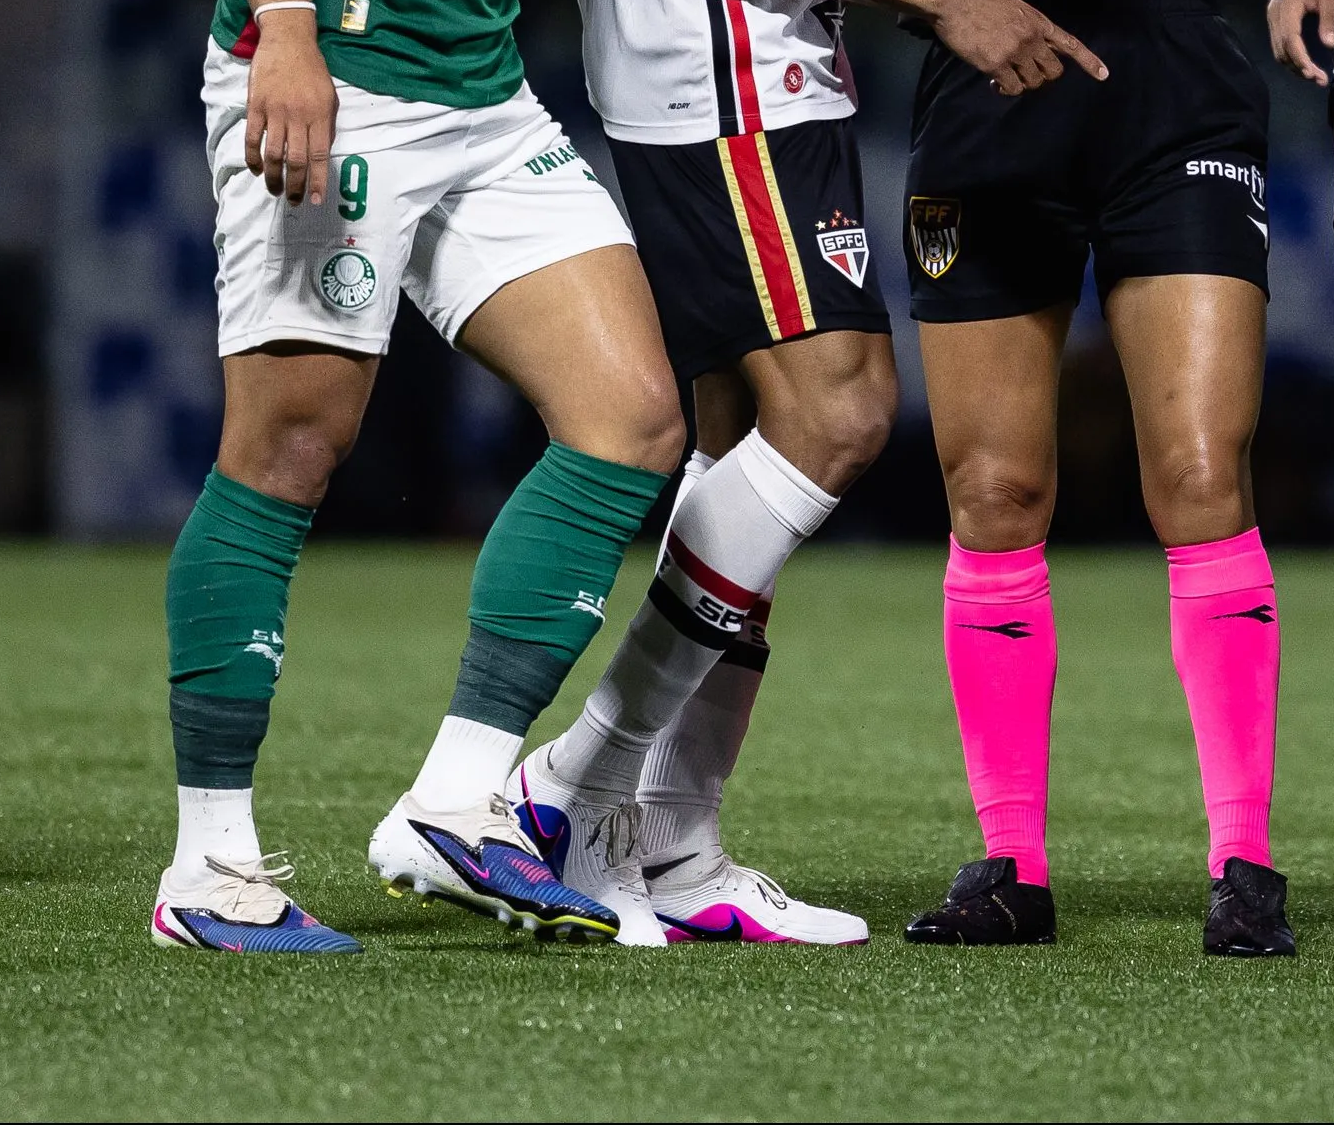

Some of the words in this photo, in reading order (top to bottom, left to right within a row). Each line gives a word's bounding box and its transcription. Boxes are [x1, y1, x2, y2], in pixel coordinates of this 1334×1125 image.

[1186, 160, 1249, 186] smart
[338, 155, 369, 222] 9
[823, 233, 864, 253] SPFC
[322, 275, 375, 307] PALMEIRAS
